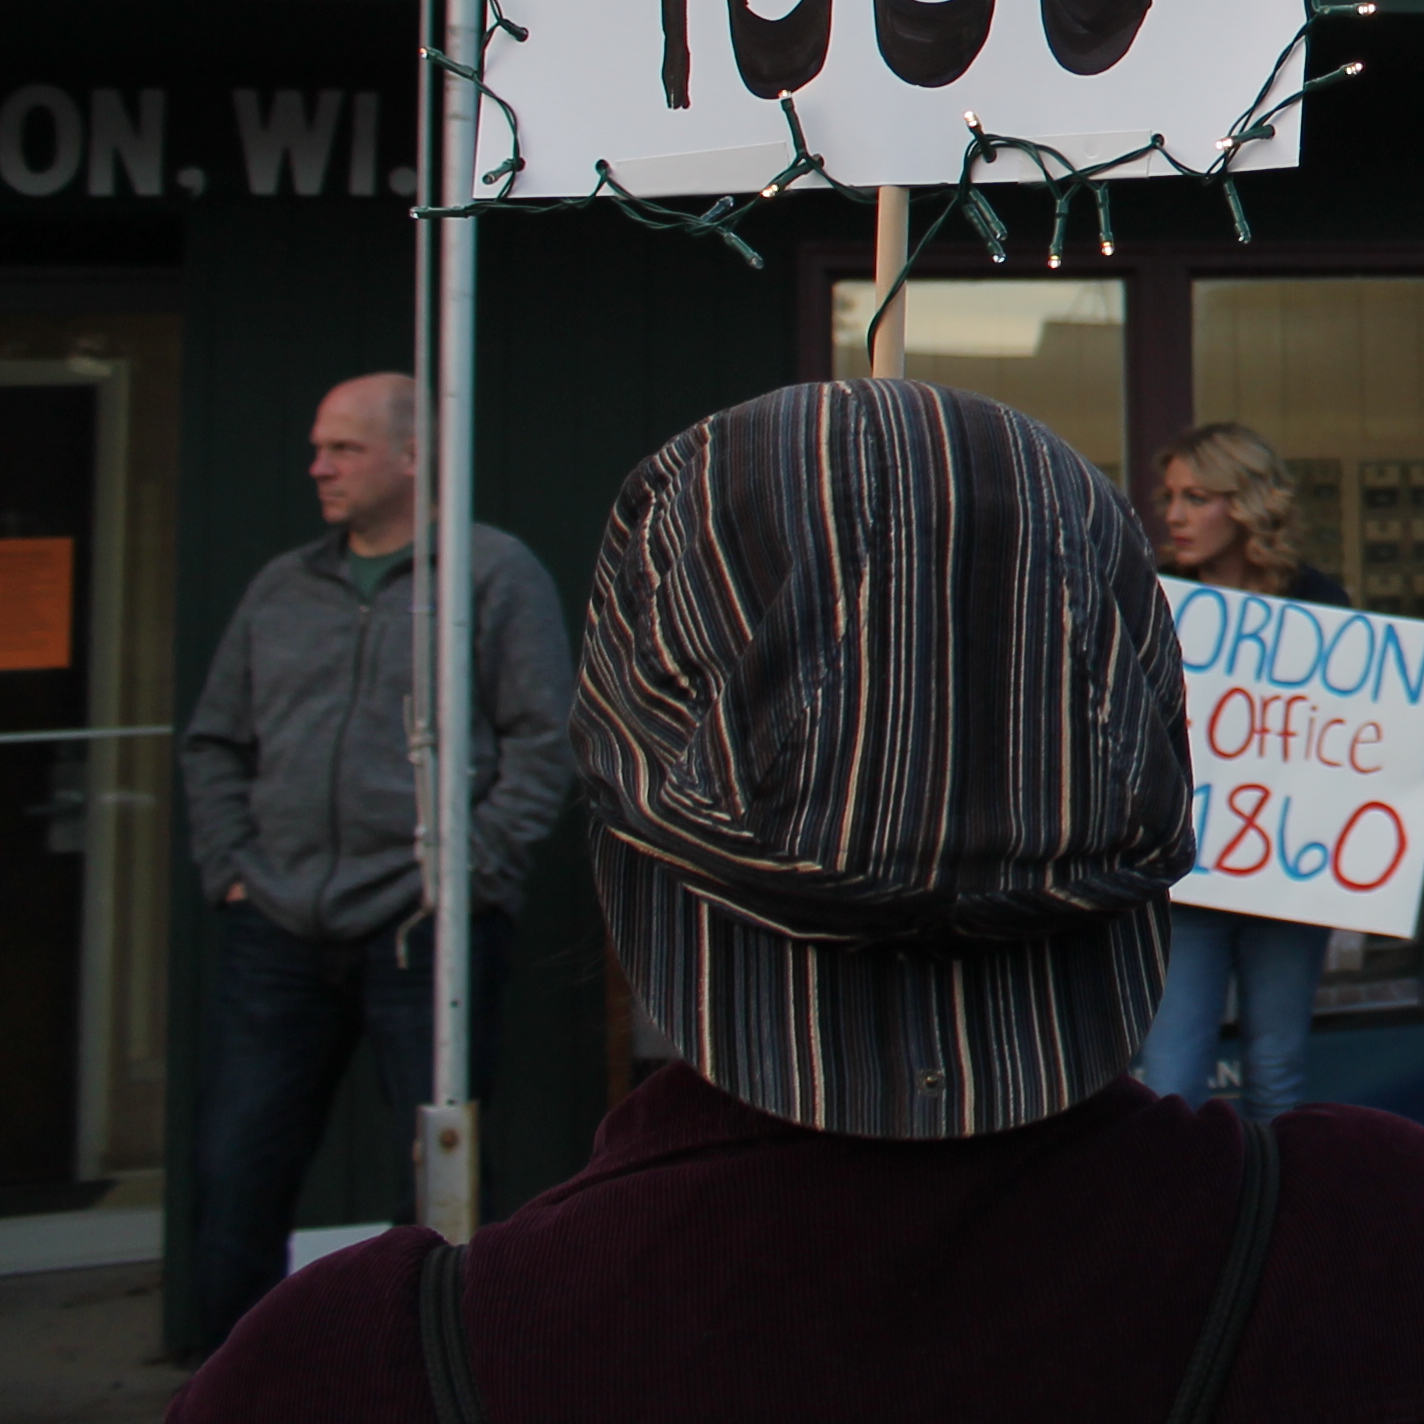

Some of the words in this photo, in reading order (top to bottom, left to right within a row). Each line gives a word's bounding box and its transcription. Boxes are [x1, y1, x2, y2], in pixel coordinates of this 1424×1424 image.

[231, 87, 418, 197] WI.
[1206, 687, 1384, 774] Office
[1193, 782, 1409, 893] 1860
